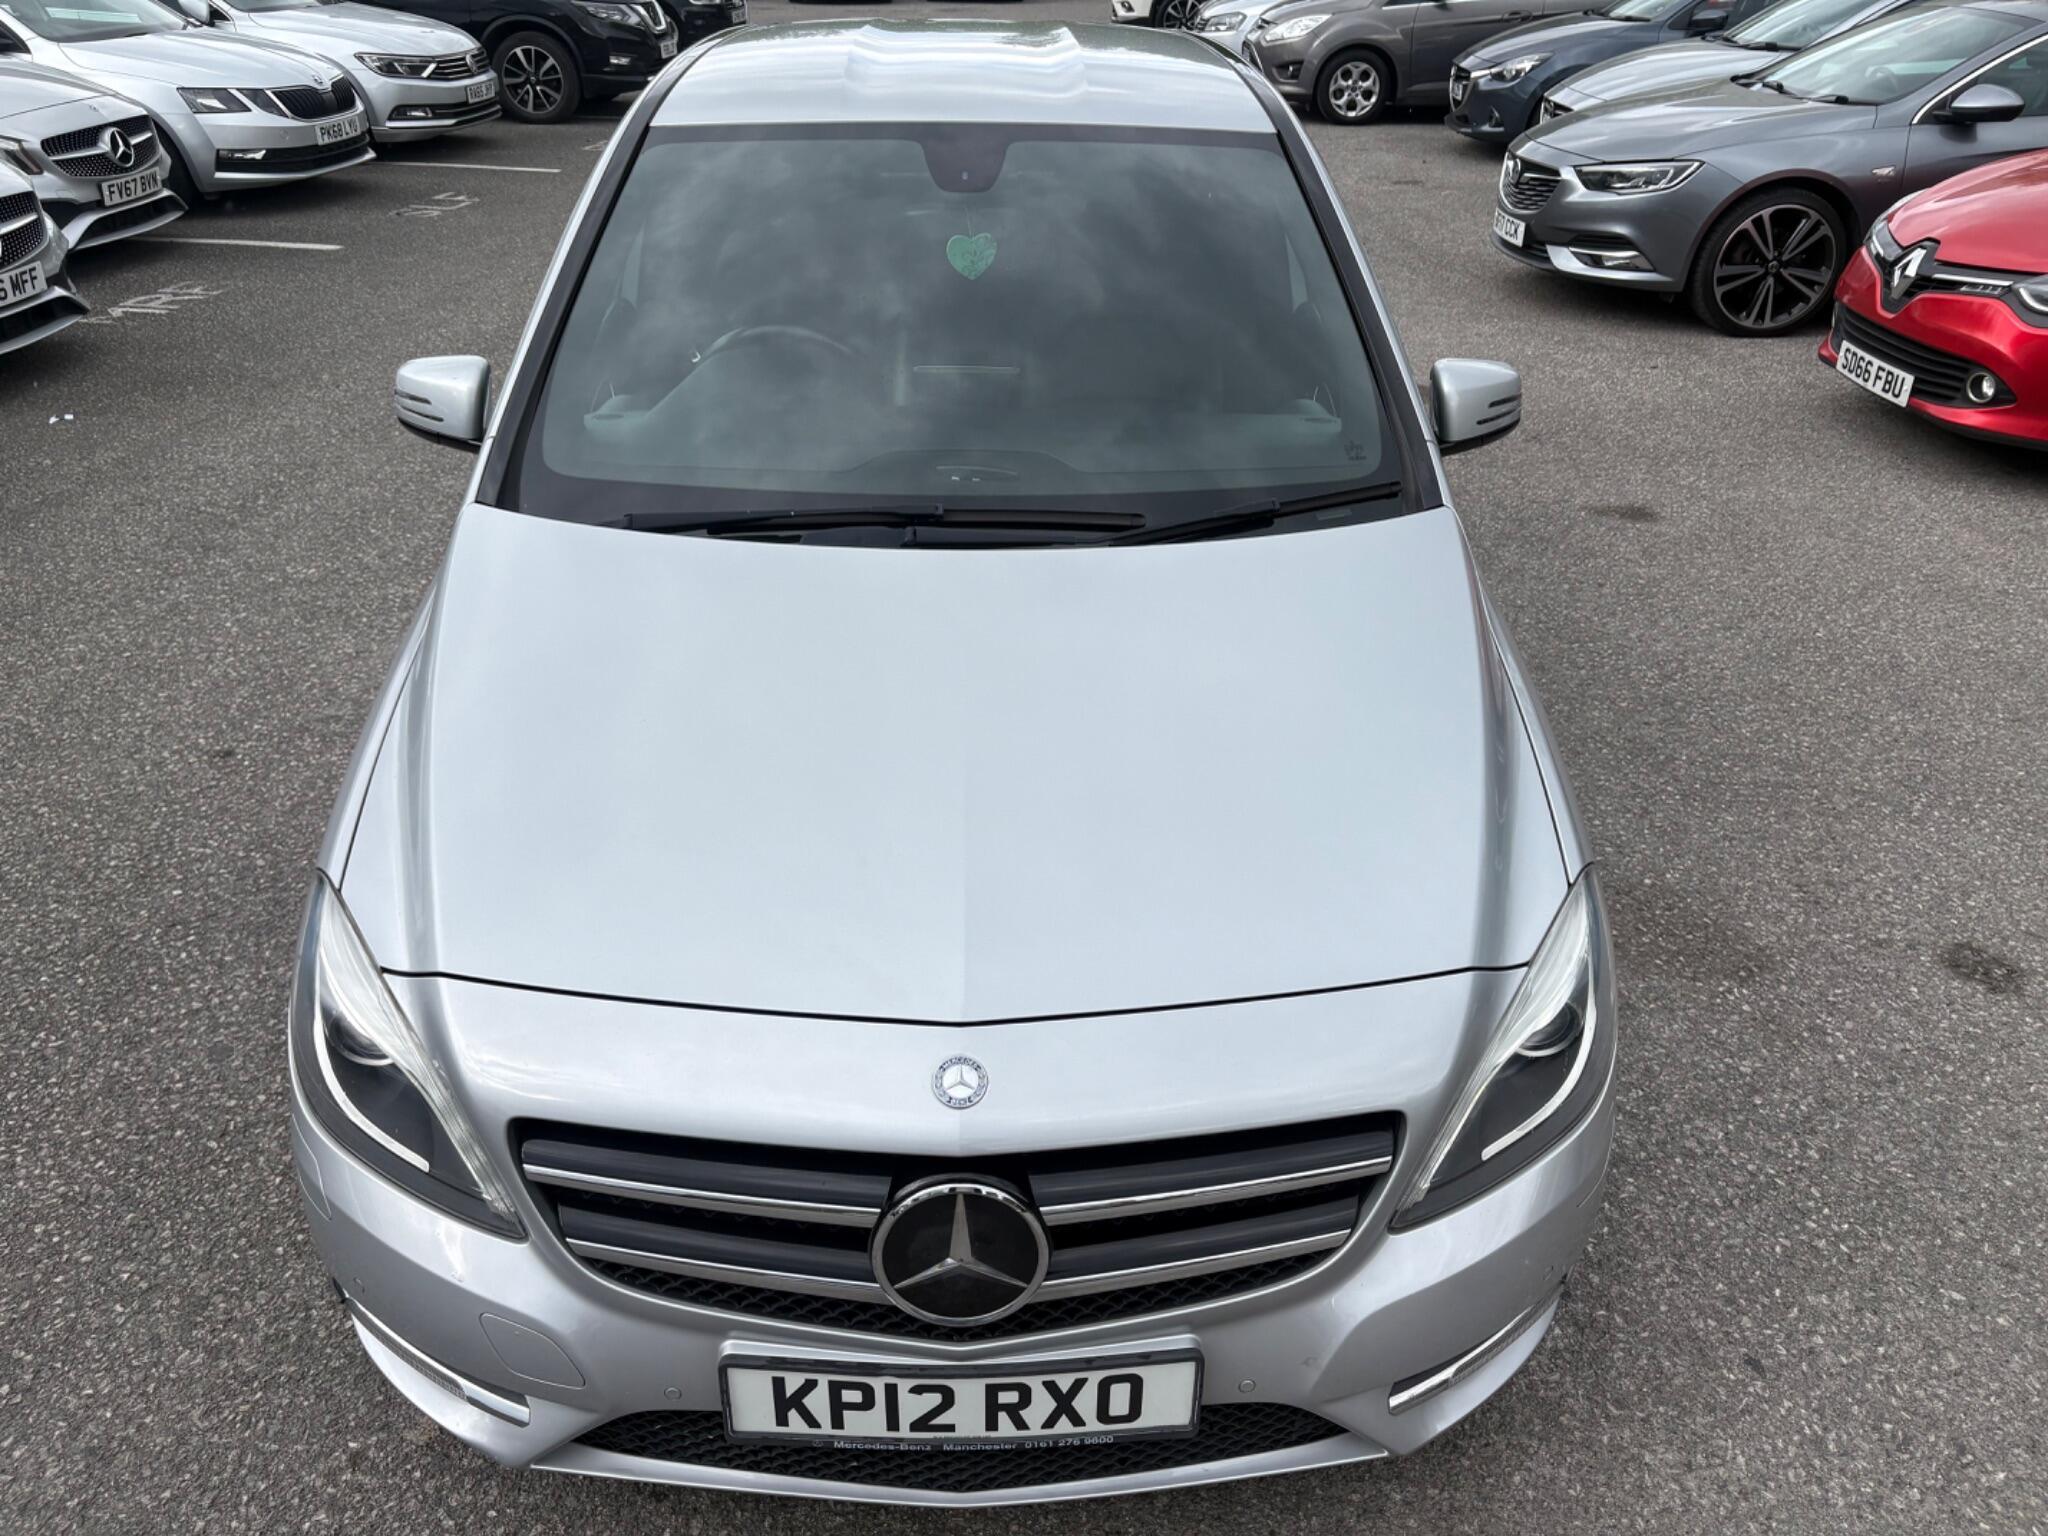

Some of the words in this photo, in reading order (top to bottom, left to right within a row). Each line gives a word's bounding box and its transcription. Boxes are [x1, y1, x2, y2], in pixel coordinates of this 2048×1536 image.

[108, 177, 138, 202] FV67
[140, 170, 159, 193] BVN
[9, 265, 38, 298] MFF
[1841, 346, 1874, 384] SD66
[1872, 364, 1906, 399] FBU
[771, 1375, 956, 1433] KP12
[984, 1373, 1144, 1432] RXO
[833, 1440, 932, 1451] Mercedes-Benz
[942, 1442, 1017, 1451] Manchester
[1025, 1440, 1054, 1450] 0161
